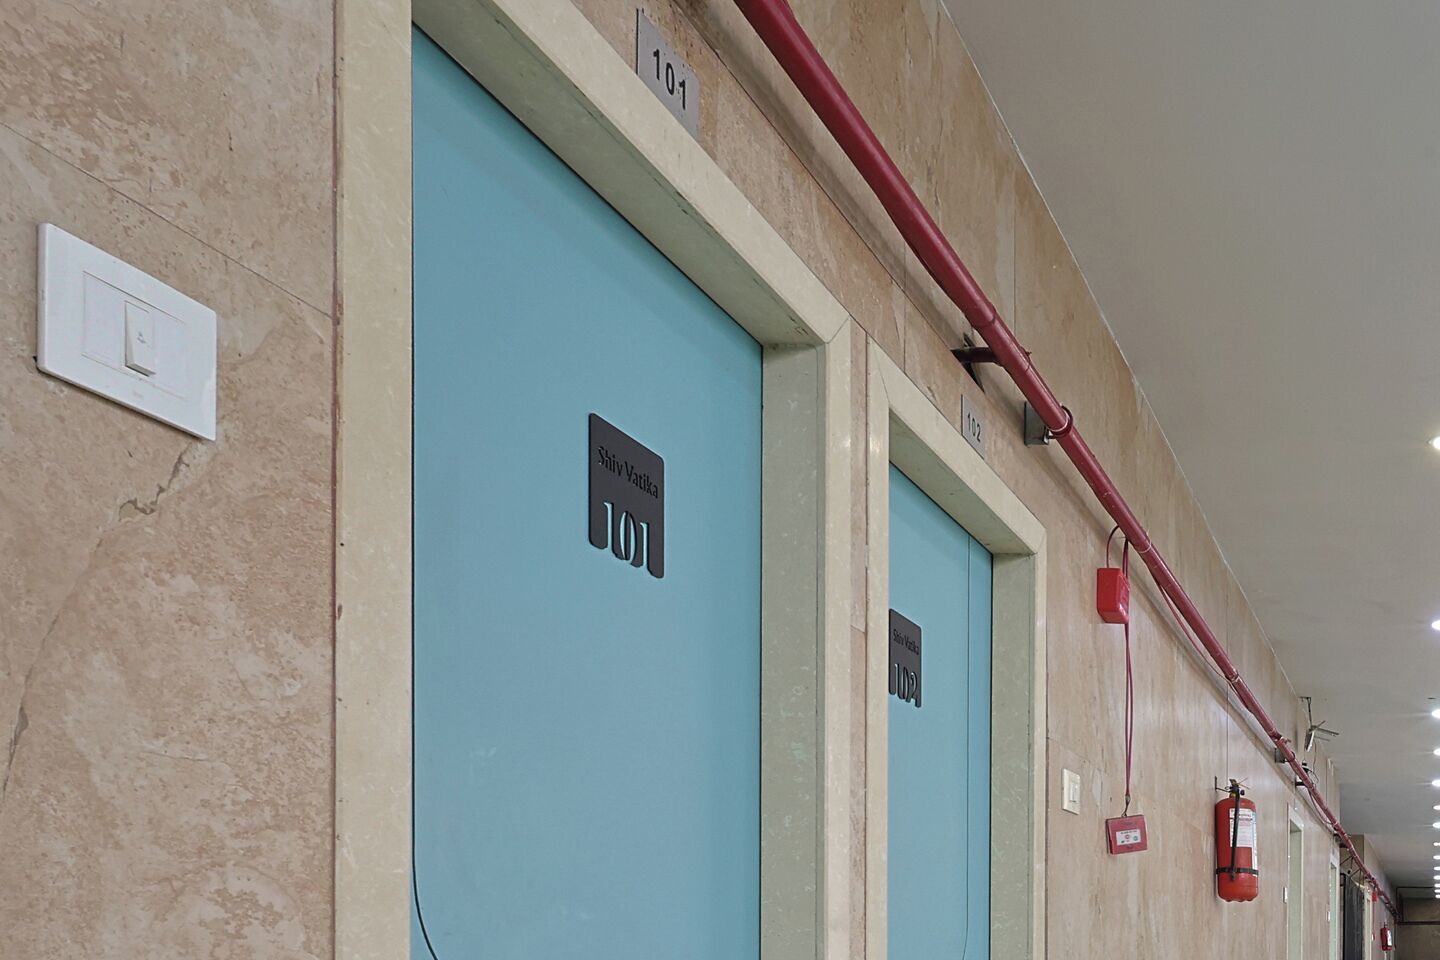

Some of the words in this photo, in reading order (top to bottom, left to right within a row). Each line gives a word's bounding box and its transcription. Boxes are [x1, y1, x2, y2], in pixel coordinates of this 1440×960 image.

[652, 48, 686, 110] 101
[967, 411, 981, 443] 102
[597, 445, 623, 477] Shiv
[624, 460, 659, 499] Vatika
[603, 501, 650, 568] 101
[894, 663, 918, 703] 102
